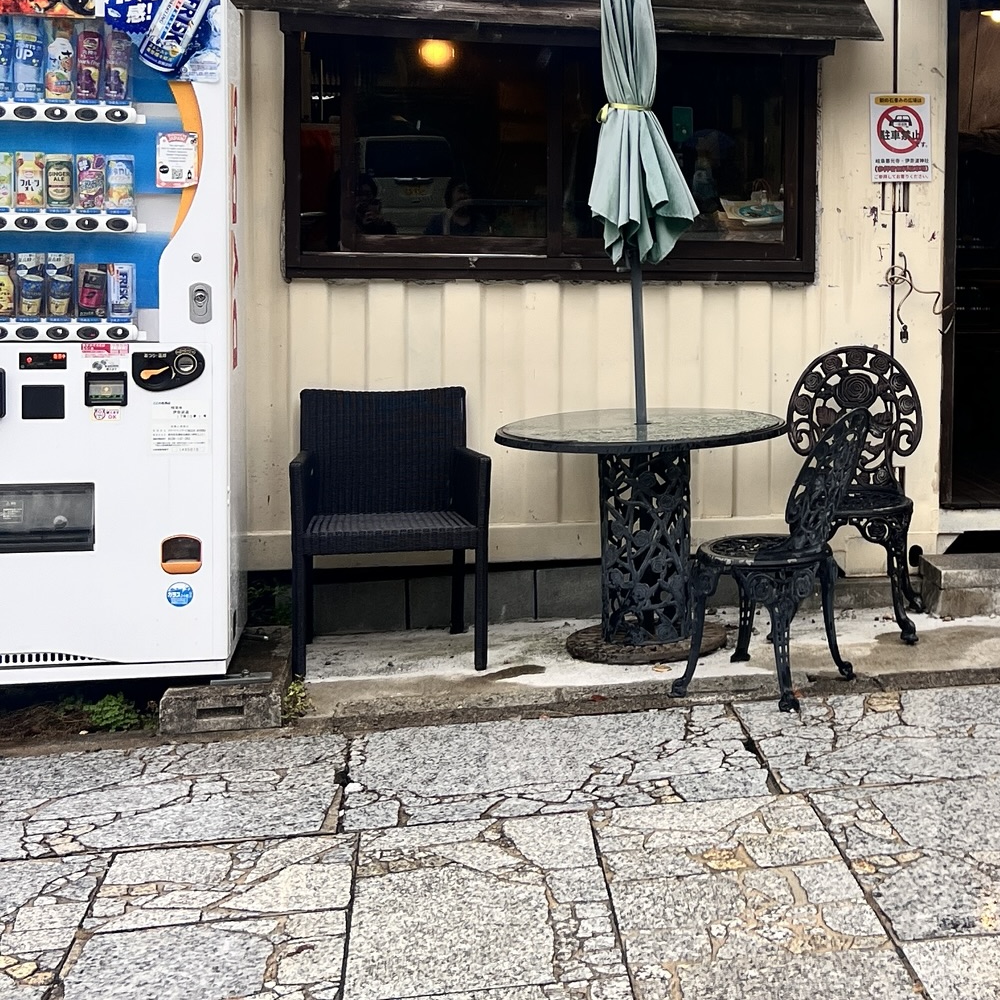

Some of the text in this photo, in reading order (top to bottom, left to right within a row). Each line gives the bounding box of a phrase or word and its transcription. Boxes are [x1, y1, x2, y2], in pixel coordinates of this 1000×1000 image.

[126, 3, 152, 24] 感!
[16, 49, 33, 60] UP
[880, 130, 920, 141] 駐車禁止
[20, 179, 40, 187] フルーツ
[119, 272, 129, 301] FRISK
